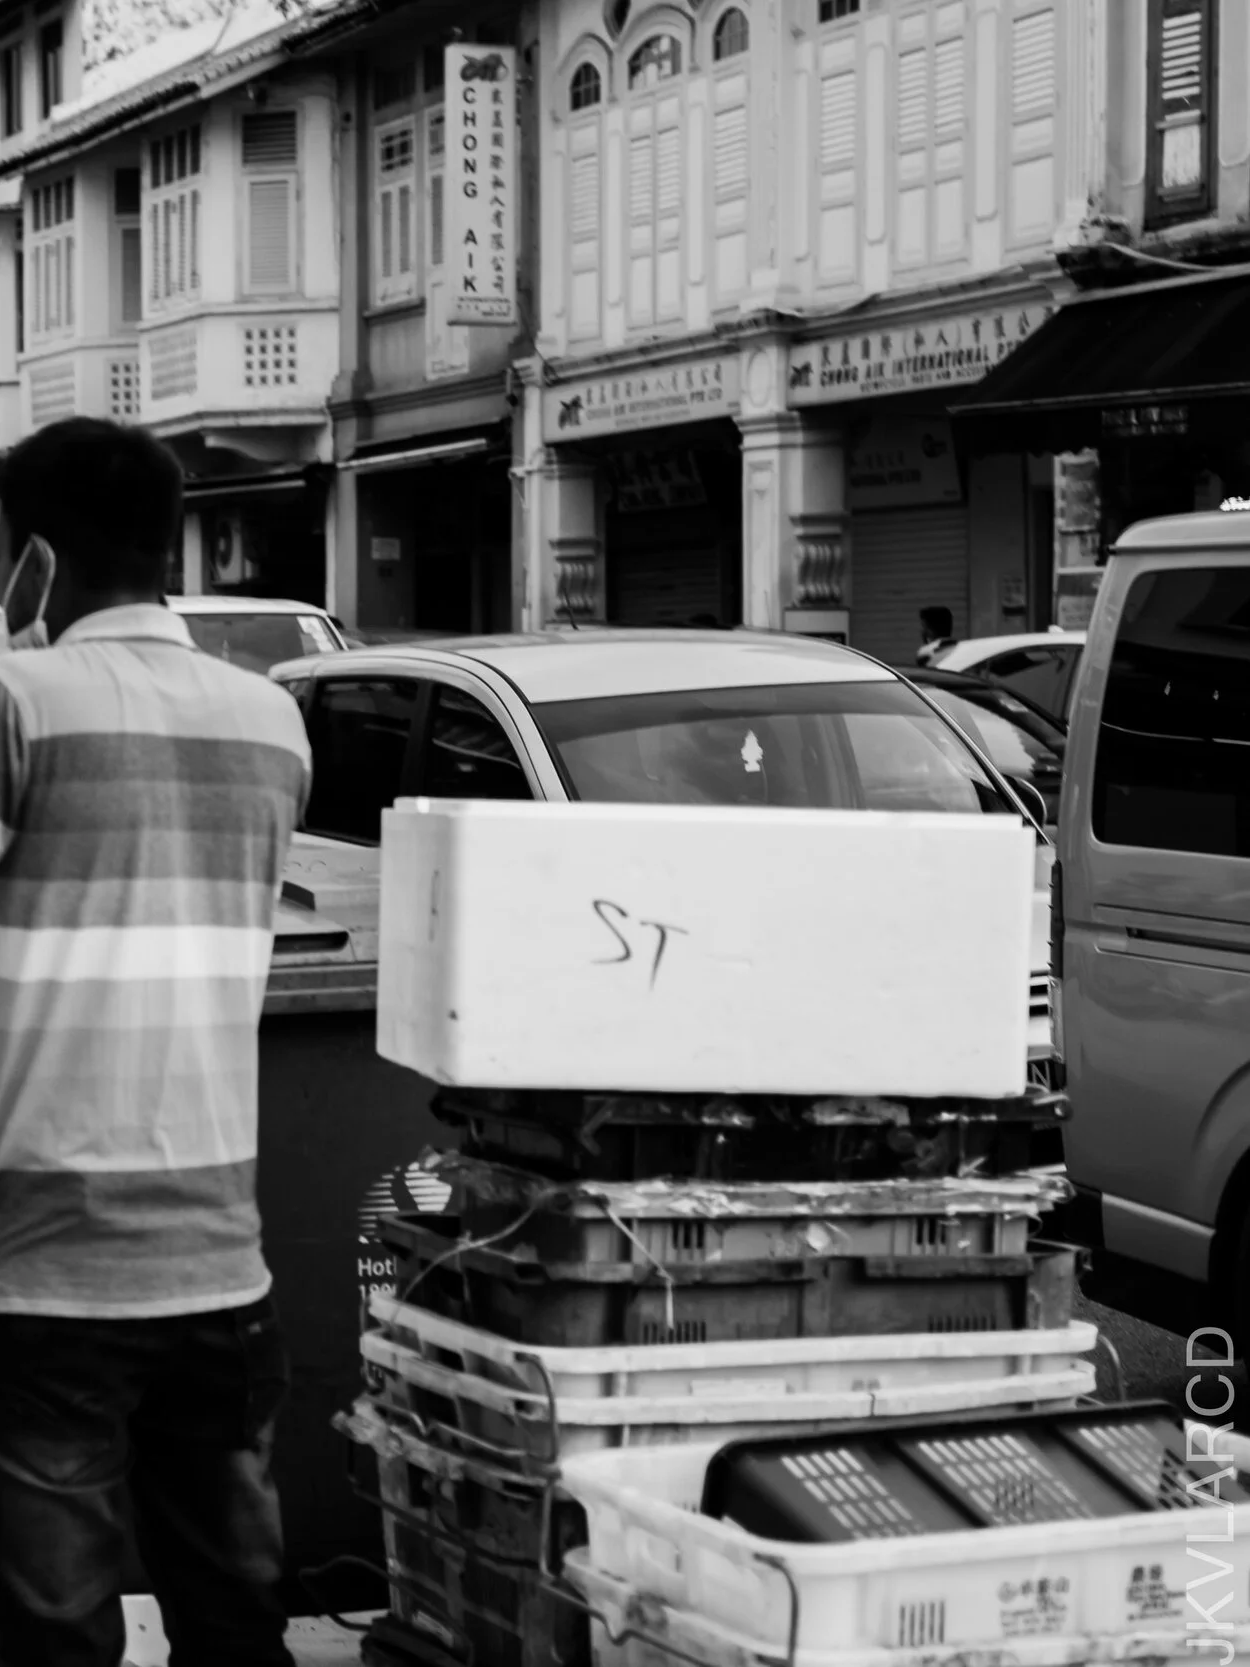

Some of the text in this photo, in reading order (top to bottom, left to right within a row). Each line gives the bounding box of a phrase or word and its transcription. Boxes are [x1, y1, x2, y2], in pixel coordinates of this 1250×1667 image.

[463, 86, 478, 293] CHONG AIK
[820, 366, 859, 388] CHONG
[865, 361, 885, 381] AIK
[892, 345, 990, 376] INTERNATIONAL
[591, 898, 689, 992] ST
